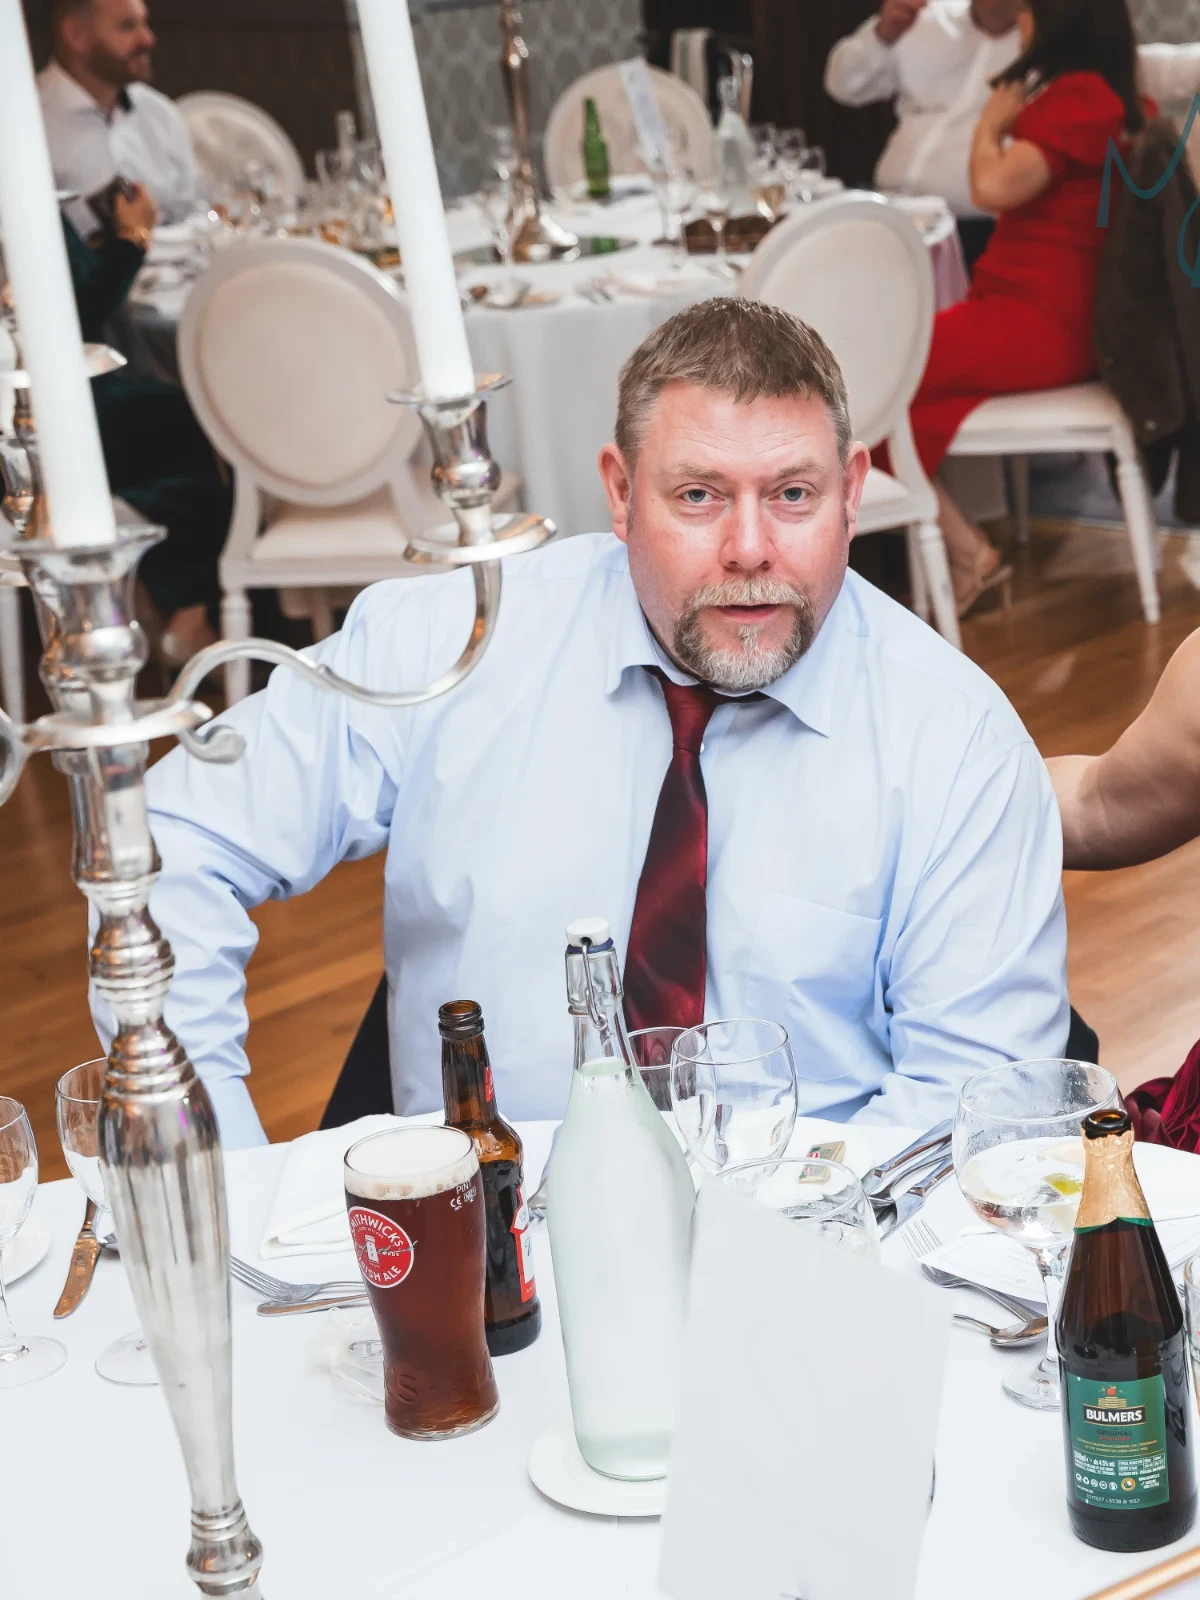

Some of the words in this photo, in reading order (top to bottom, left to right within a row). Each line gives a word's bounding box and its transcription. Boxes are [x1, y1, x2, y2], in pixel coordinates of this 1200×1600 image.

[382, 1265, 402, 1281] ALE
[1085, 1408, 1143, 1423] BULMERS
[1096, 1429, 1132, 1437] ORIGINAL
